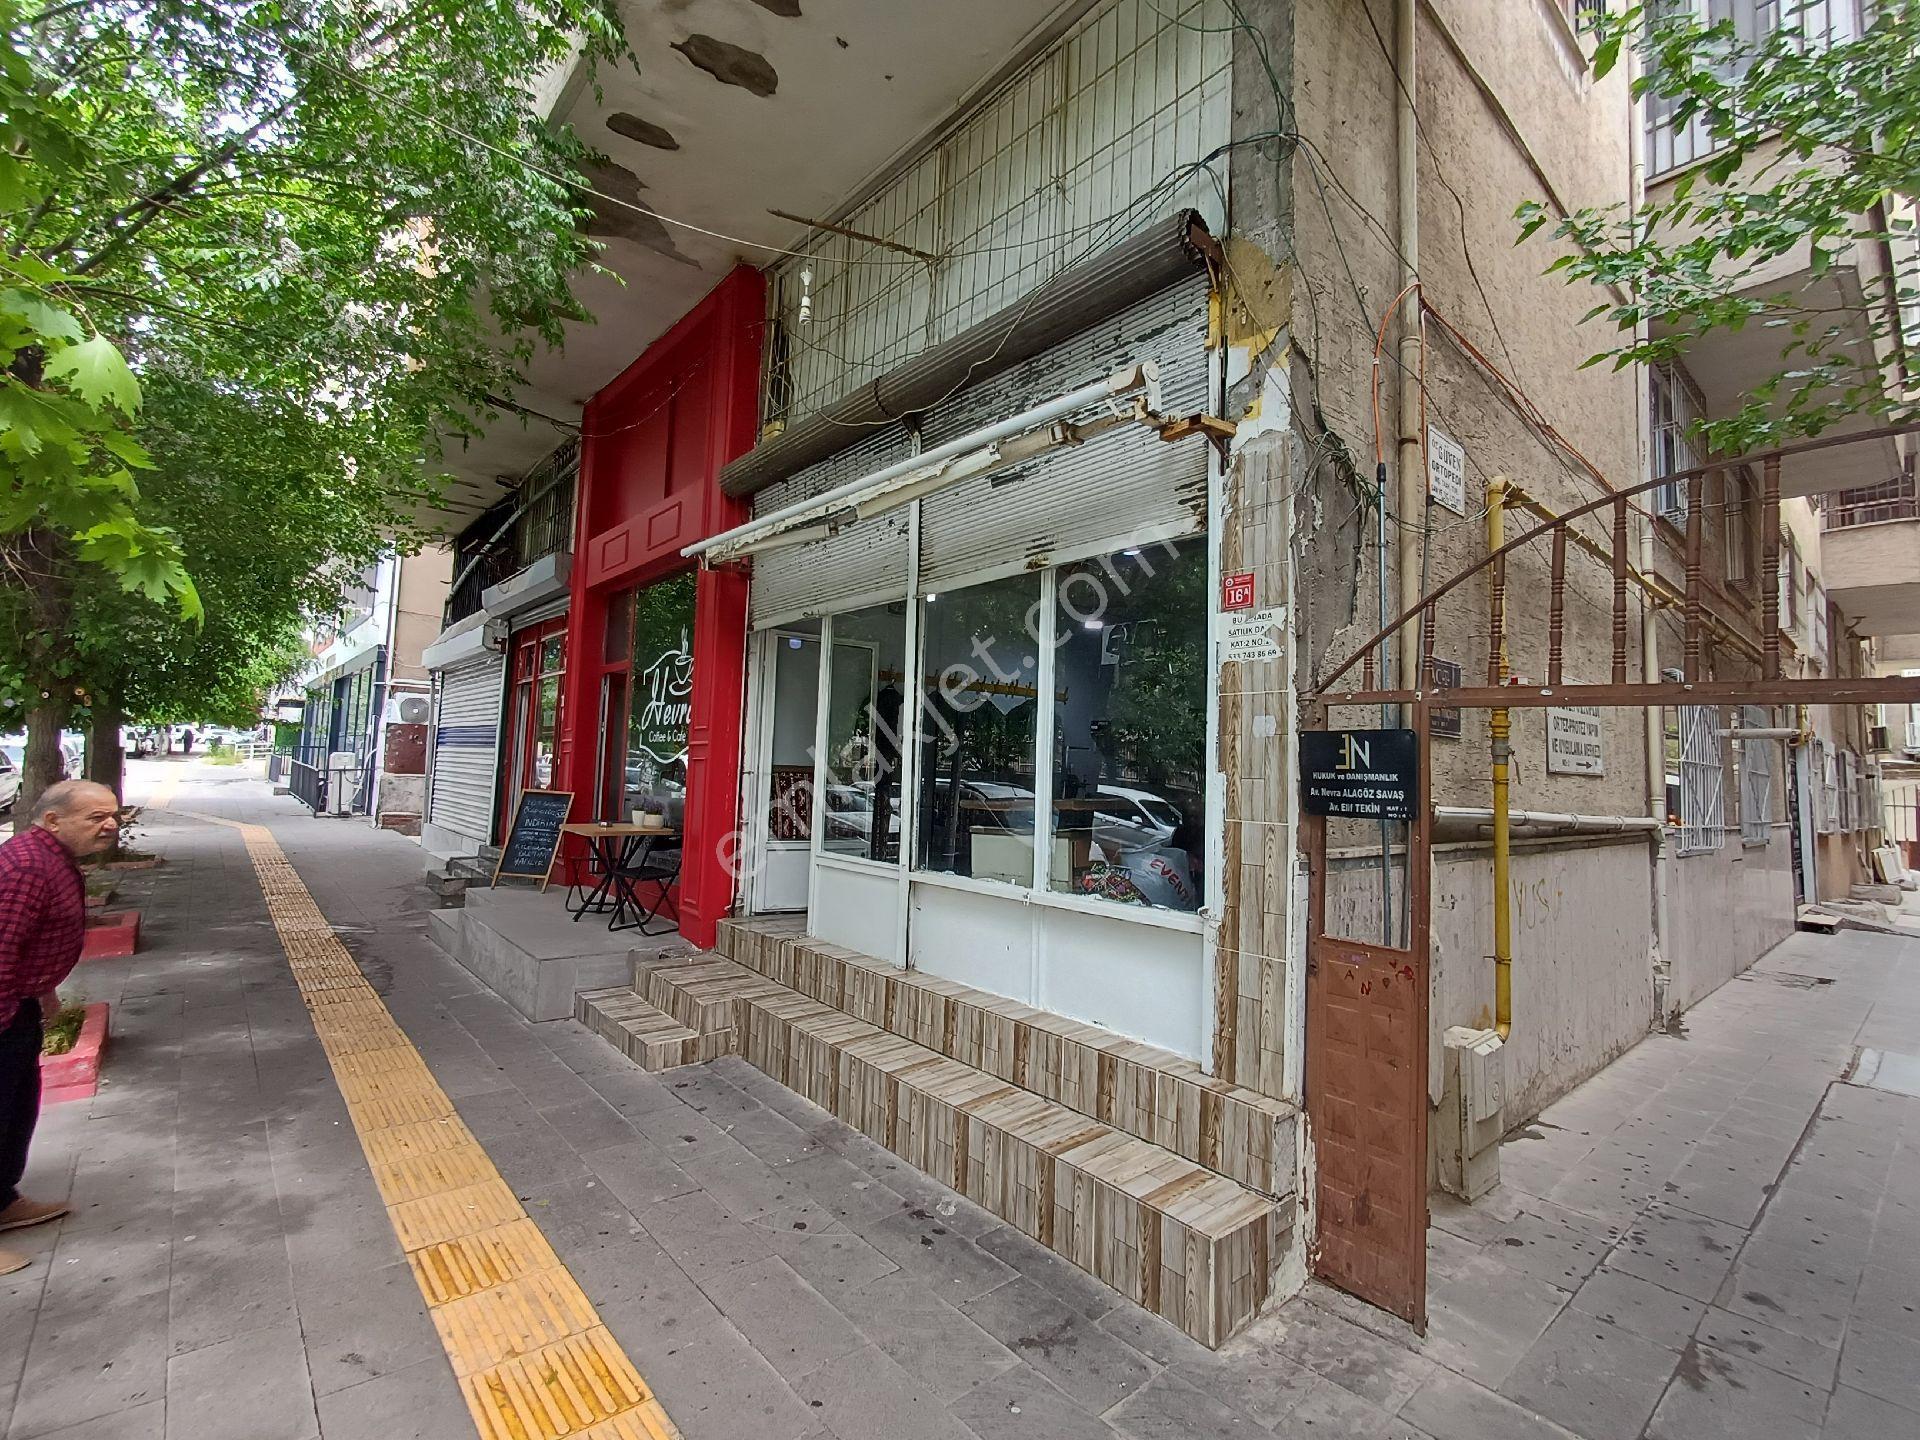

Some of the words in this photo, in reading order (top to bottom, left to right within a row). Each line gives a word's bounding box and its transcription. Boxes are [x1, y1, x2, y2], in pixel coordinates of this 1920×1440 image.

[1232, 617, 1243, 625] BU
[1228, 628, 1253, 637] SATILIK
[648, 731, 666, 743] Coffee
[1346, 773, 1399, 782] DANIŞMANLIK
[1342, 788, 1375, 799] ALAGÖZ
[1376, 790, 1405, 802] SAVAŞ
[1354, 802, 1380, 814] TEKİN
